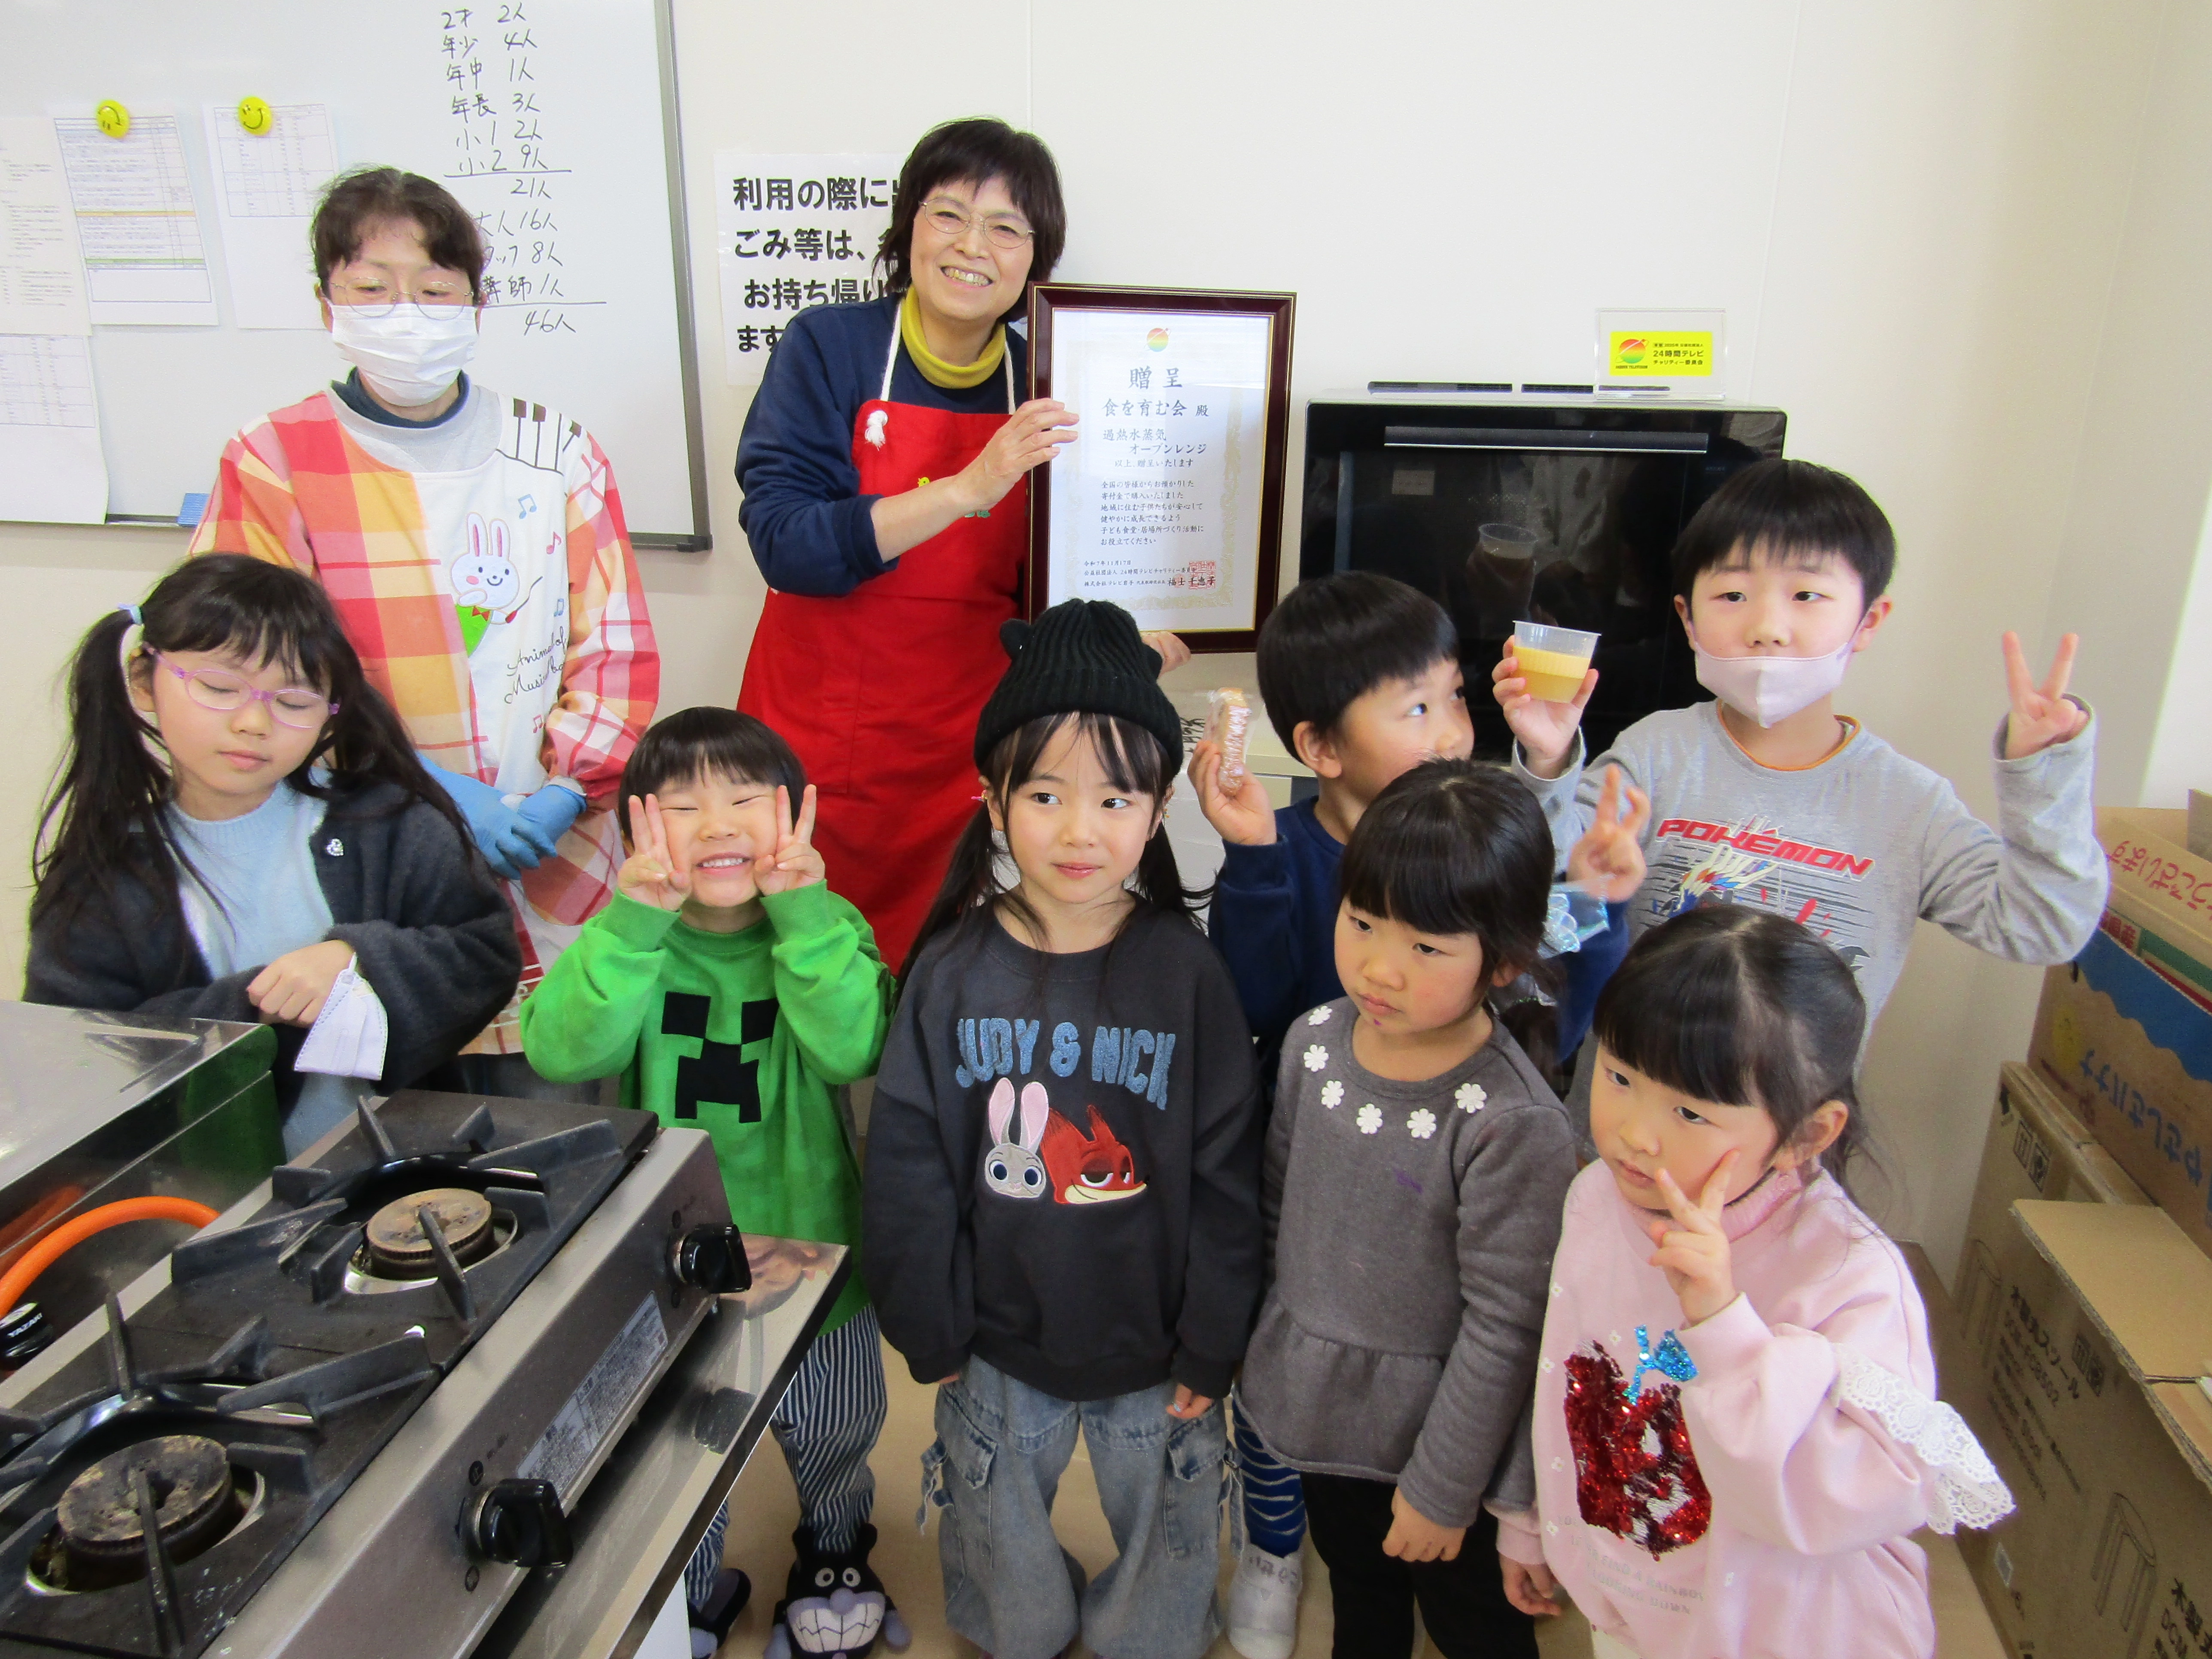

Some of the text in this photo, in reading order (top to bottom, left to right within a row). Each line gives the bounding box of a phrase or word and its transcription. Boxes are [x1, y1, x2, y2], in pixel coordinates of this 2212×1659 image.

[497, 3, 527, 23] 2人
[441, 29, 538, 58] 年少 4人
[447, 57, 534, 91] 年中 1人
[452, 92, 541, 123] 年長 3人
[514, 118, 543, 141] 2人
[521, 144, 548, 170] 9人
[511, 177, 552, 199] 21人
[520, 208, 558, 232] 16人
[532, 241, 563, 267] 8人
[540, 273, 565, 298] 1人
[524, 309, 577, 336] 46人
[1128, 365, 1183, 389] 贈呈
[1102, 398, 1209, 417] 食を育む会 殿
[1103, 428, 1167, 441] 過熱水蒸気
[1130, 443, 1207, 456] オーブンレンジ
[955, 1018, 1176, 1110] JUDY & NICK
